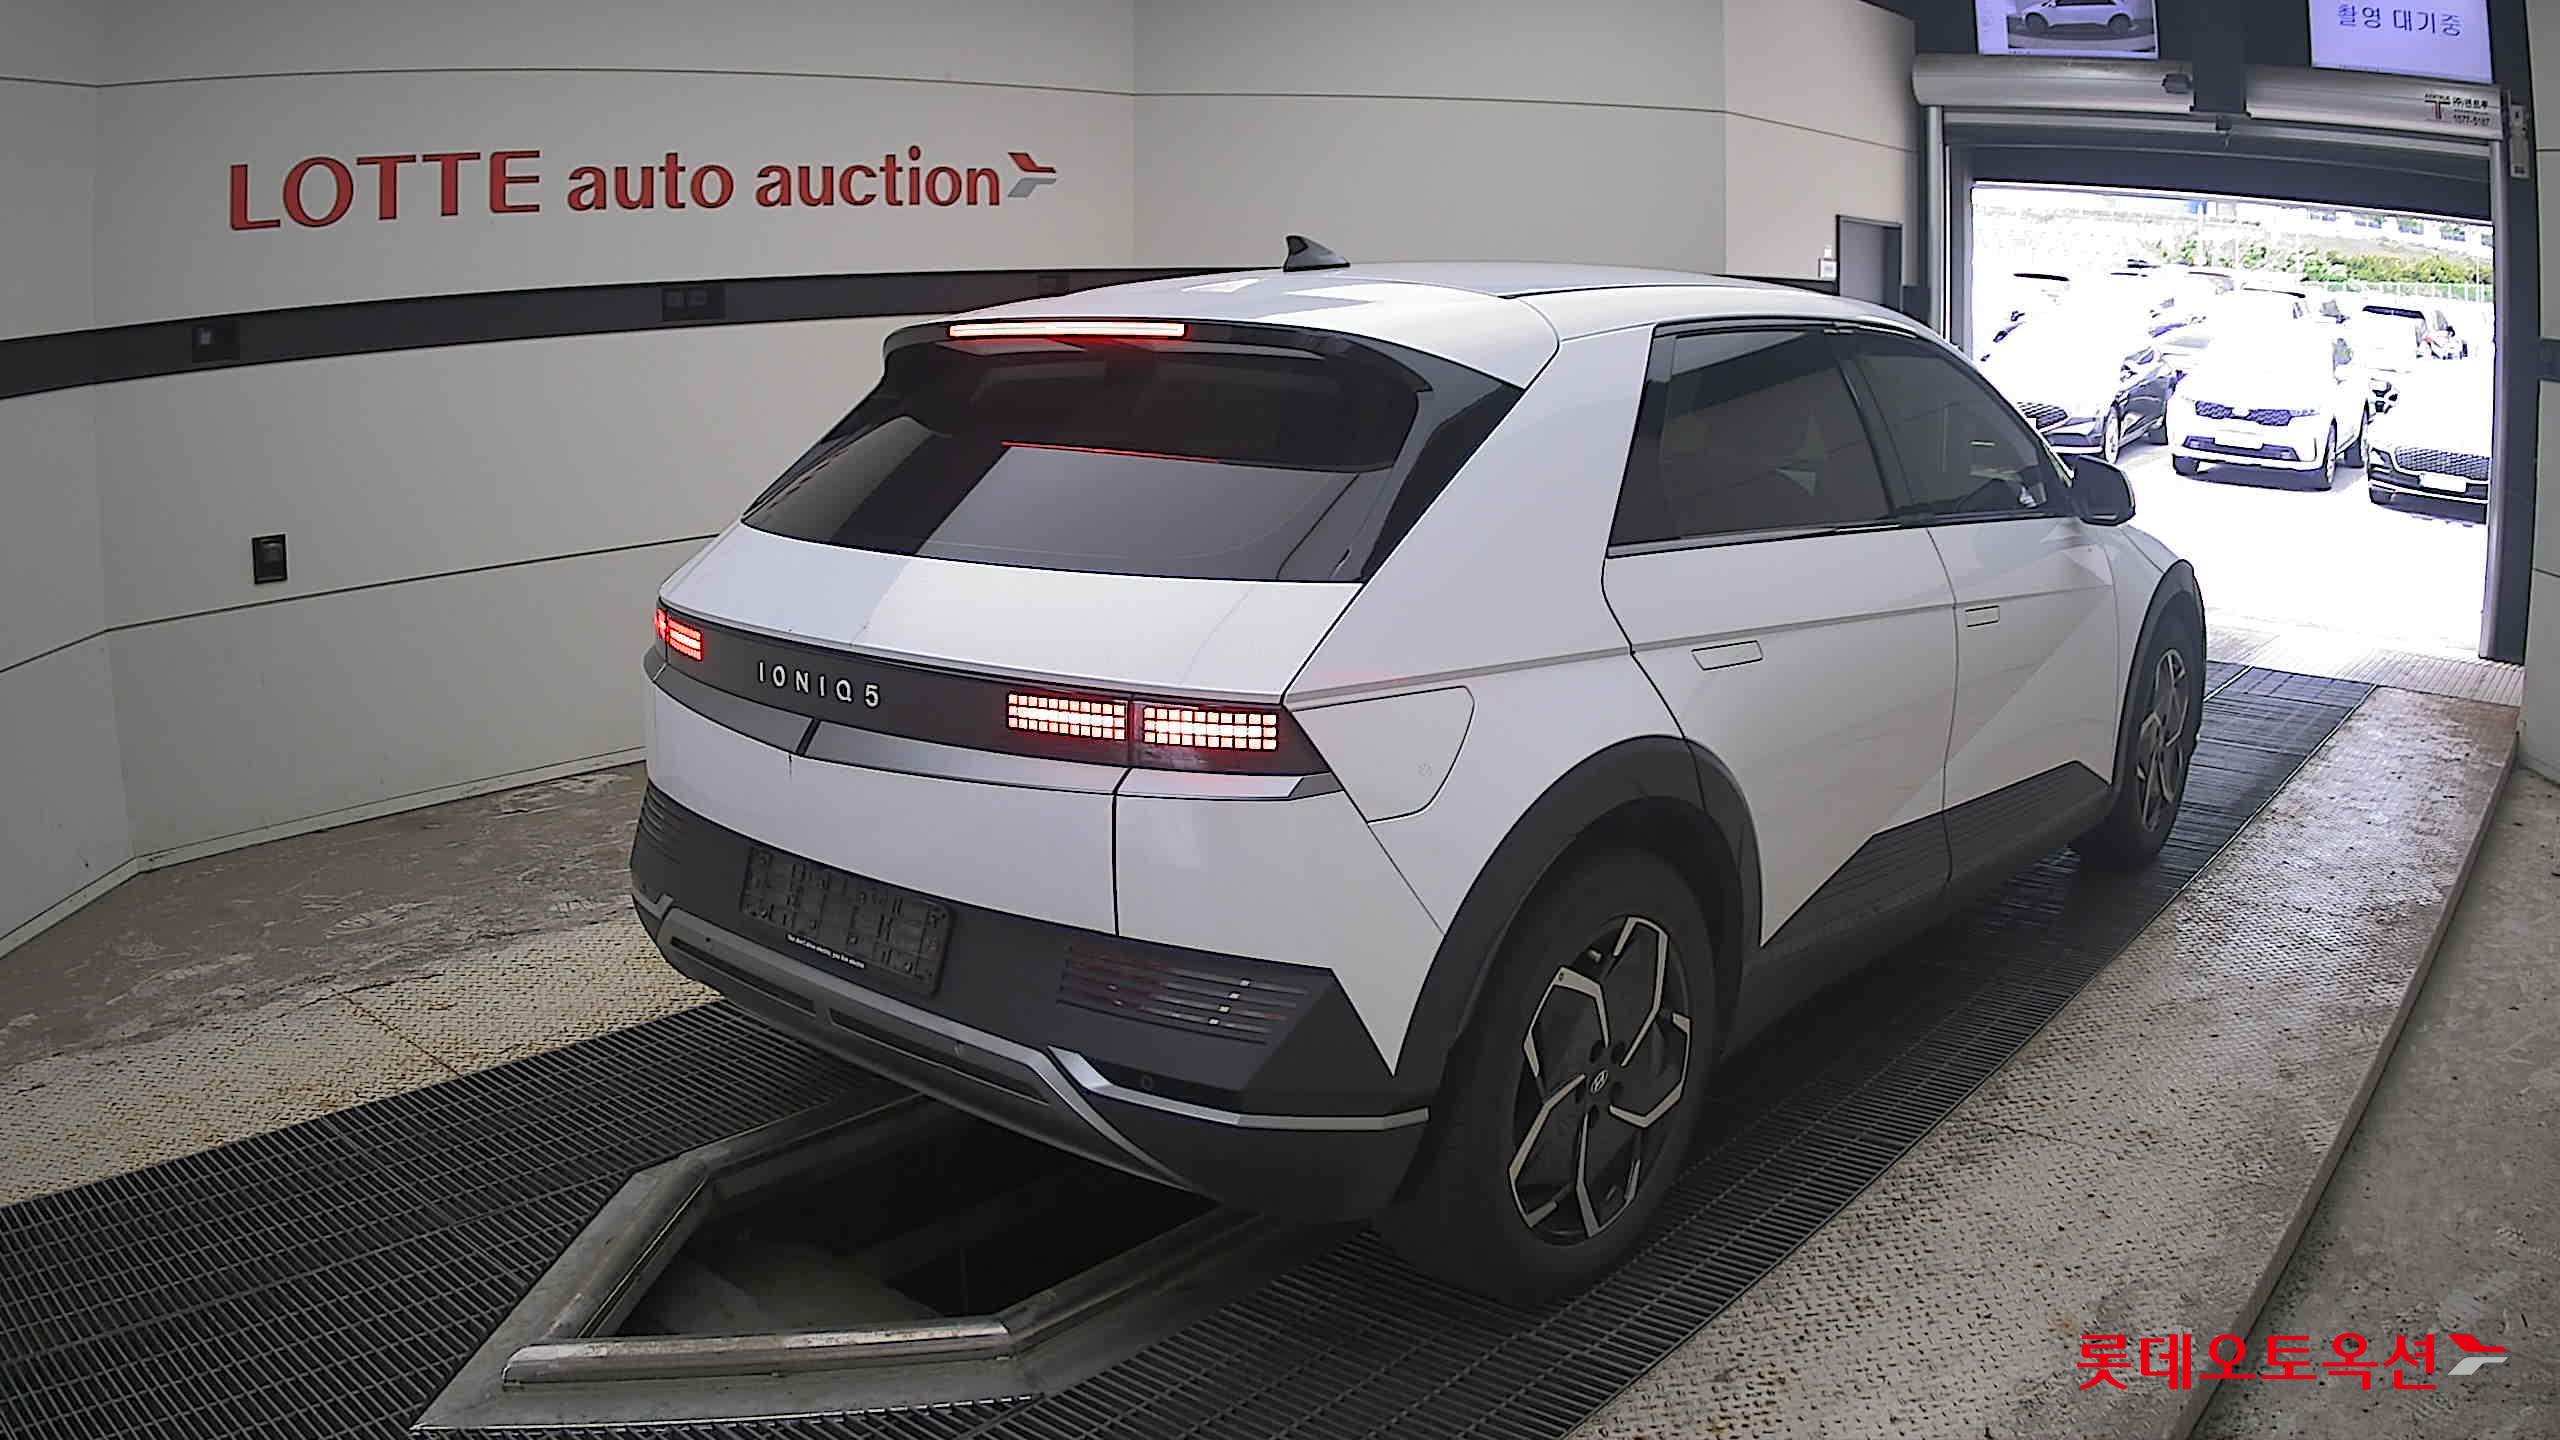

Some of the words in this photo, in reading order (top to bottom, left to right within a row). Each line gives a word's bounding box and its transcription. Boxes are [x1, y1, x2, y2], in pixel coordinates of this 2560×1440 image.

[2338, 4, 2382, 29] 촬영
[2393, 9, 2461, 37] 대기중
[230, 150, 540, 230] LOTTE
[567, 152, 735, 210] auto
[756, 145, 1001, 207] auction
[759, 661, 852, 703] IONIQ
[865, 684, 880, 708] 5
